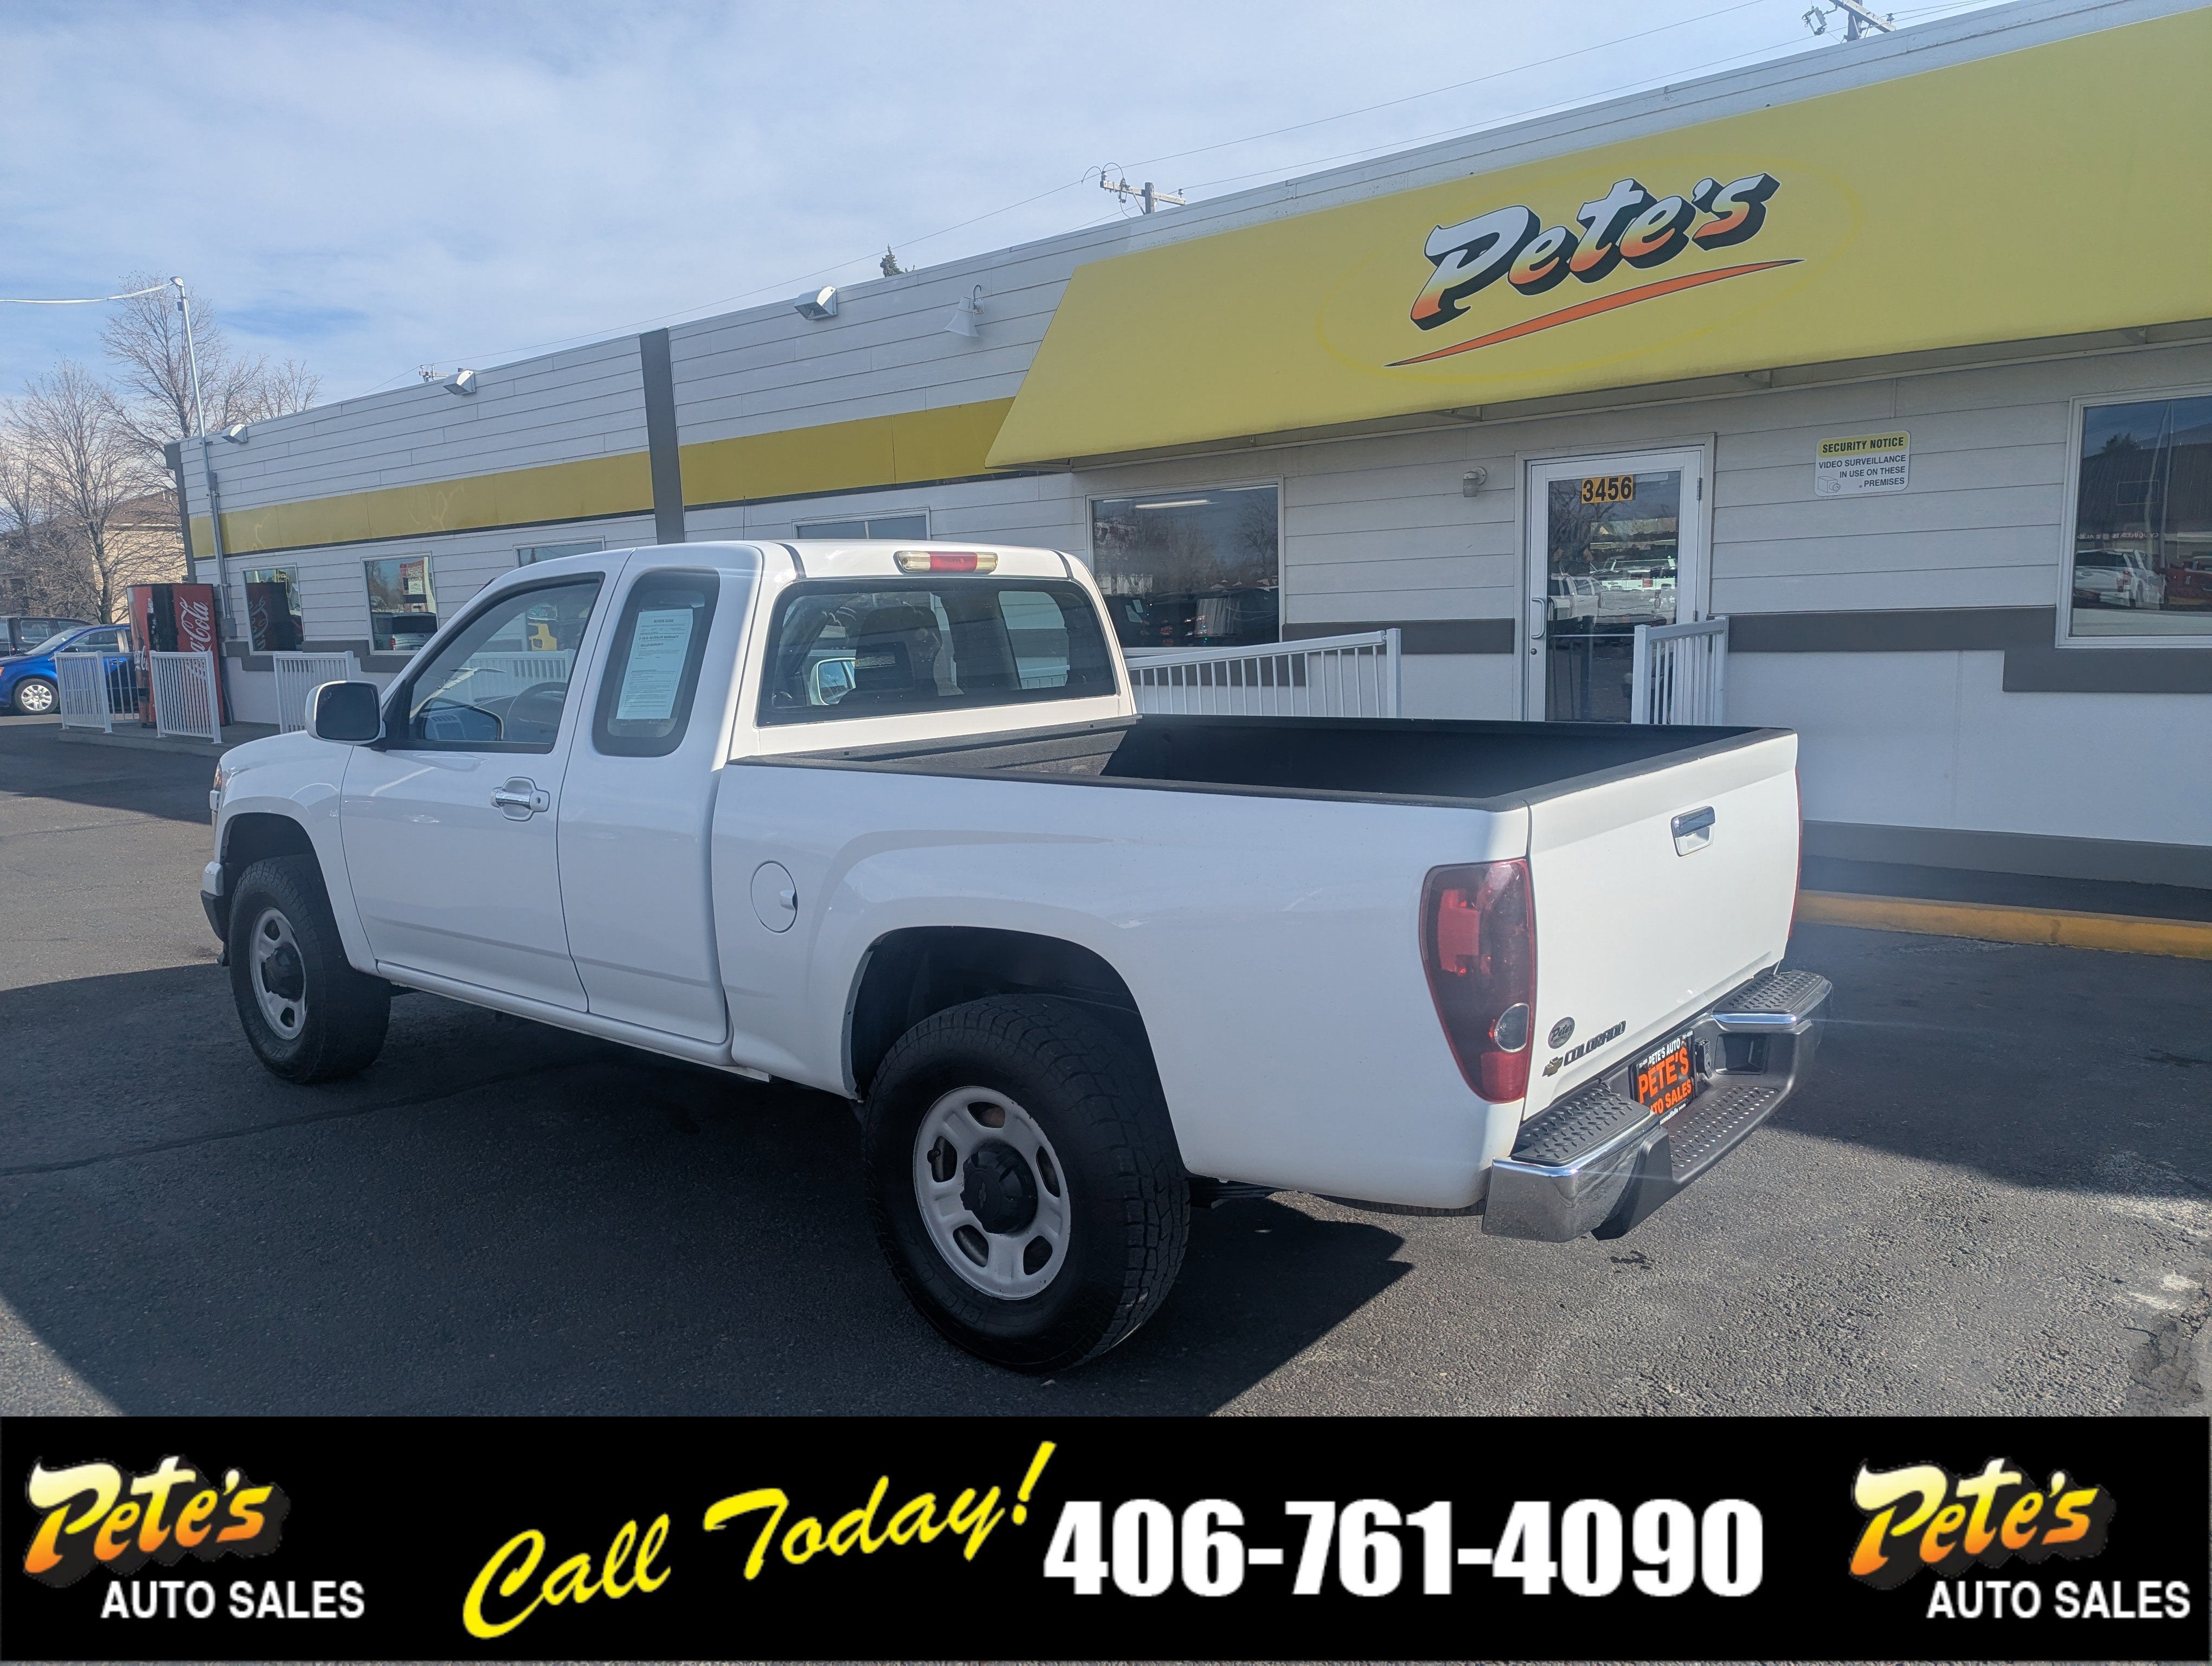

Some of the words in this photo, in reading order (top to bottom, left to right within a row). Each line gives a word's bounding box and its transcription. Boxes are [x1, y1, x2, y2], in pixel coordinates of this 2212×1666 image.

[1410, 172, 1780, 331] Pete's
[1822, 440, 1867, 453] SECURITY
[1870, 437, 1904, 449] NOTICE
[1819, 460, 1842, 469] VIDEO
[1844, 454, 1906, 467] SURVEILLANCE
[1880, 466, 1906, 475] THESE
[1583, 476, 1632, 502] 3456
[1864, 477, 1905, 488] PREMISES
[1564, 1020, 1626, 1067] COLORADO
[1649, 1047, 1666, 1065] PETE'S
[1667, 1037, 1680, 1056] AUTO
[1638, 1046, 1689, 1104] PETE'S
[1650, 1098, 1664, 1114] TO
[1665, 1079, 1692, 1108] SALES
